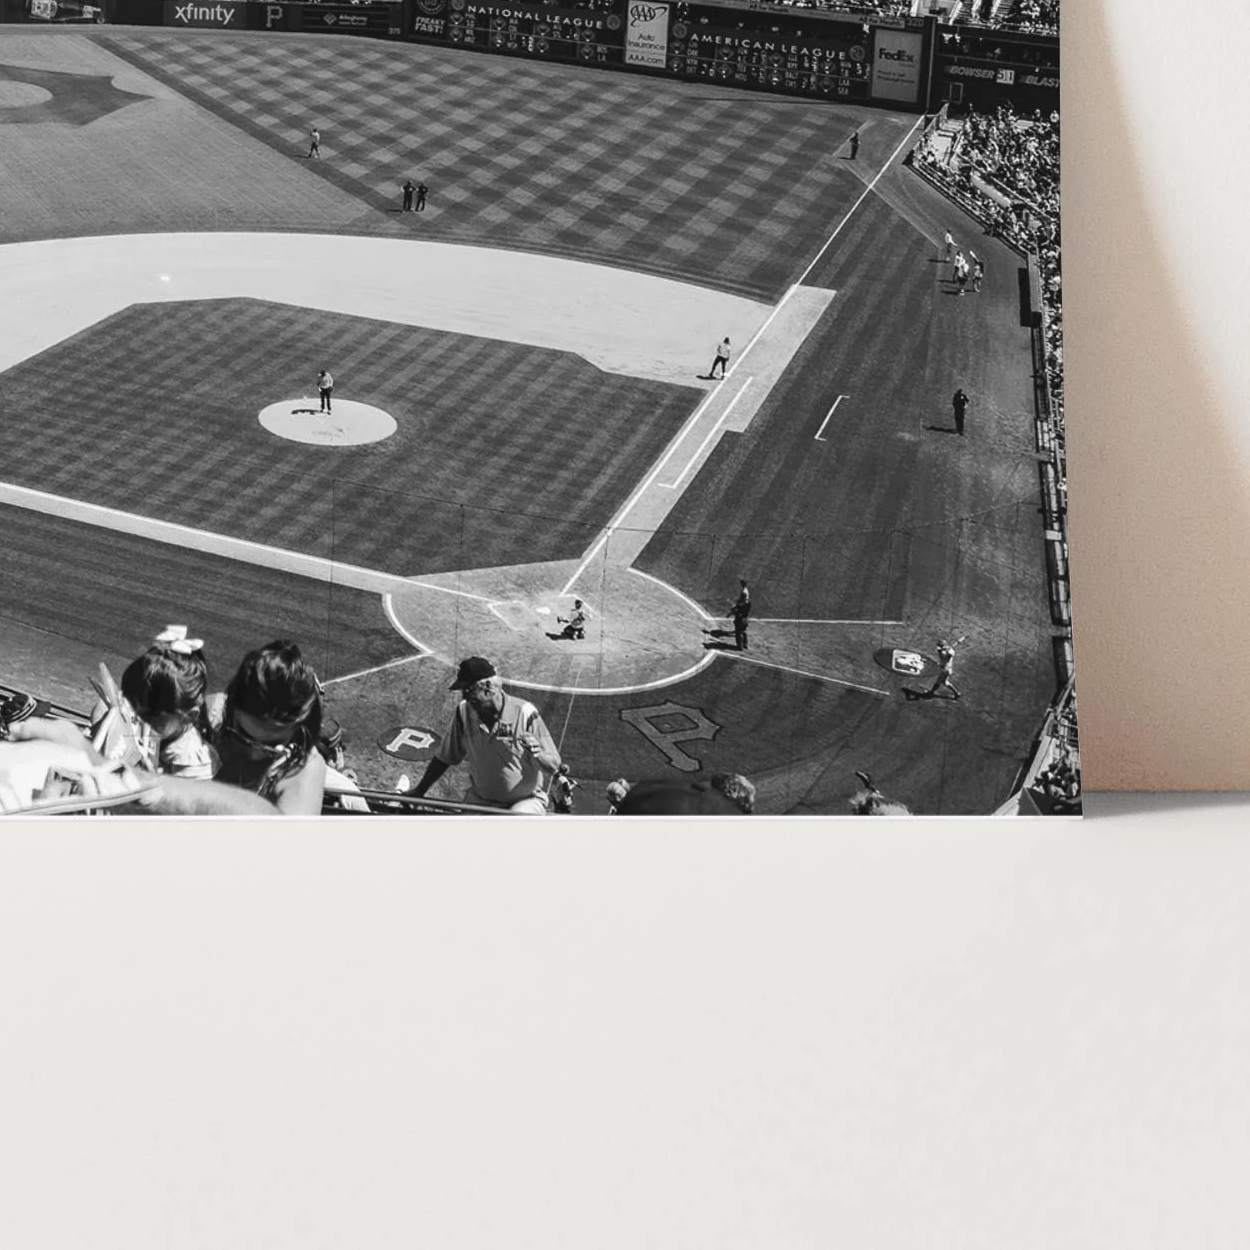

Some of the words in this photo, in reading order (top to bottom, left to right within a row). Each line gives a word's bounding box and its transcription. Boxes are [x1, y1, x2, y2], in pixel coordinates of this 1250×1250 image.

[174, 3, 235, 25] xfinity
[467, 5, 541, 21] NATIONAL
[547, 14, 603, 30] LEAGUE
[691, 33, 775, 51] AMERICAN
[782, 43, 846, 60] LEAGUE
[879, 47, 915, 63] FedEx
[949, 65, 996, 80] BOWSER
